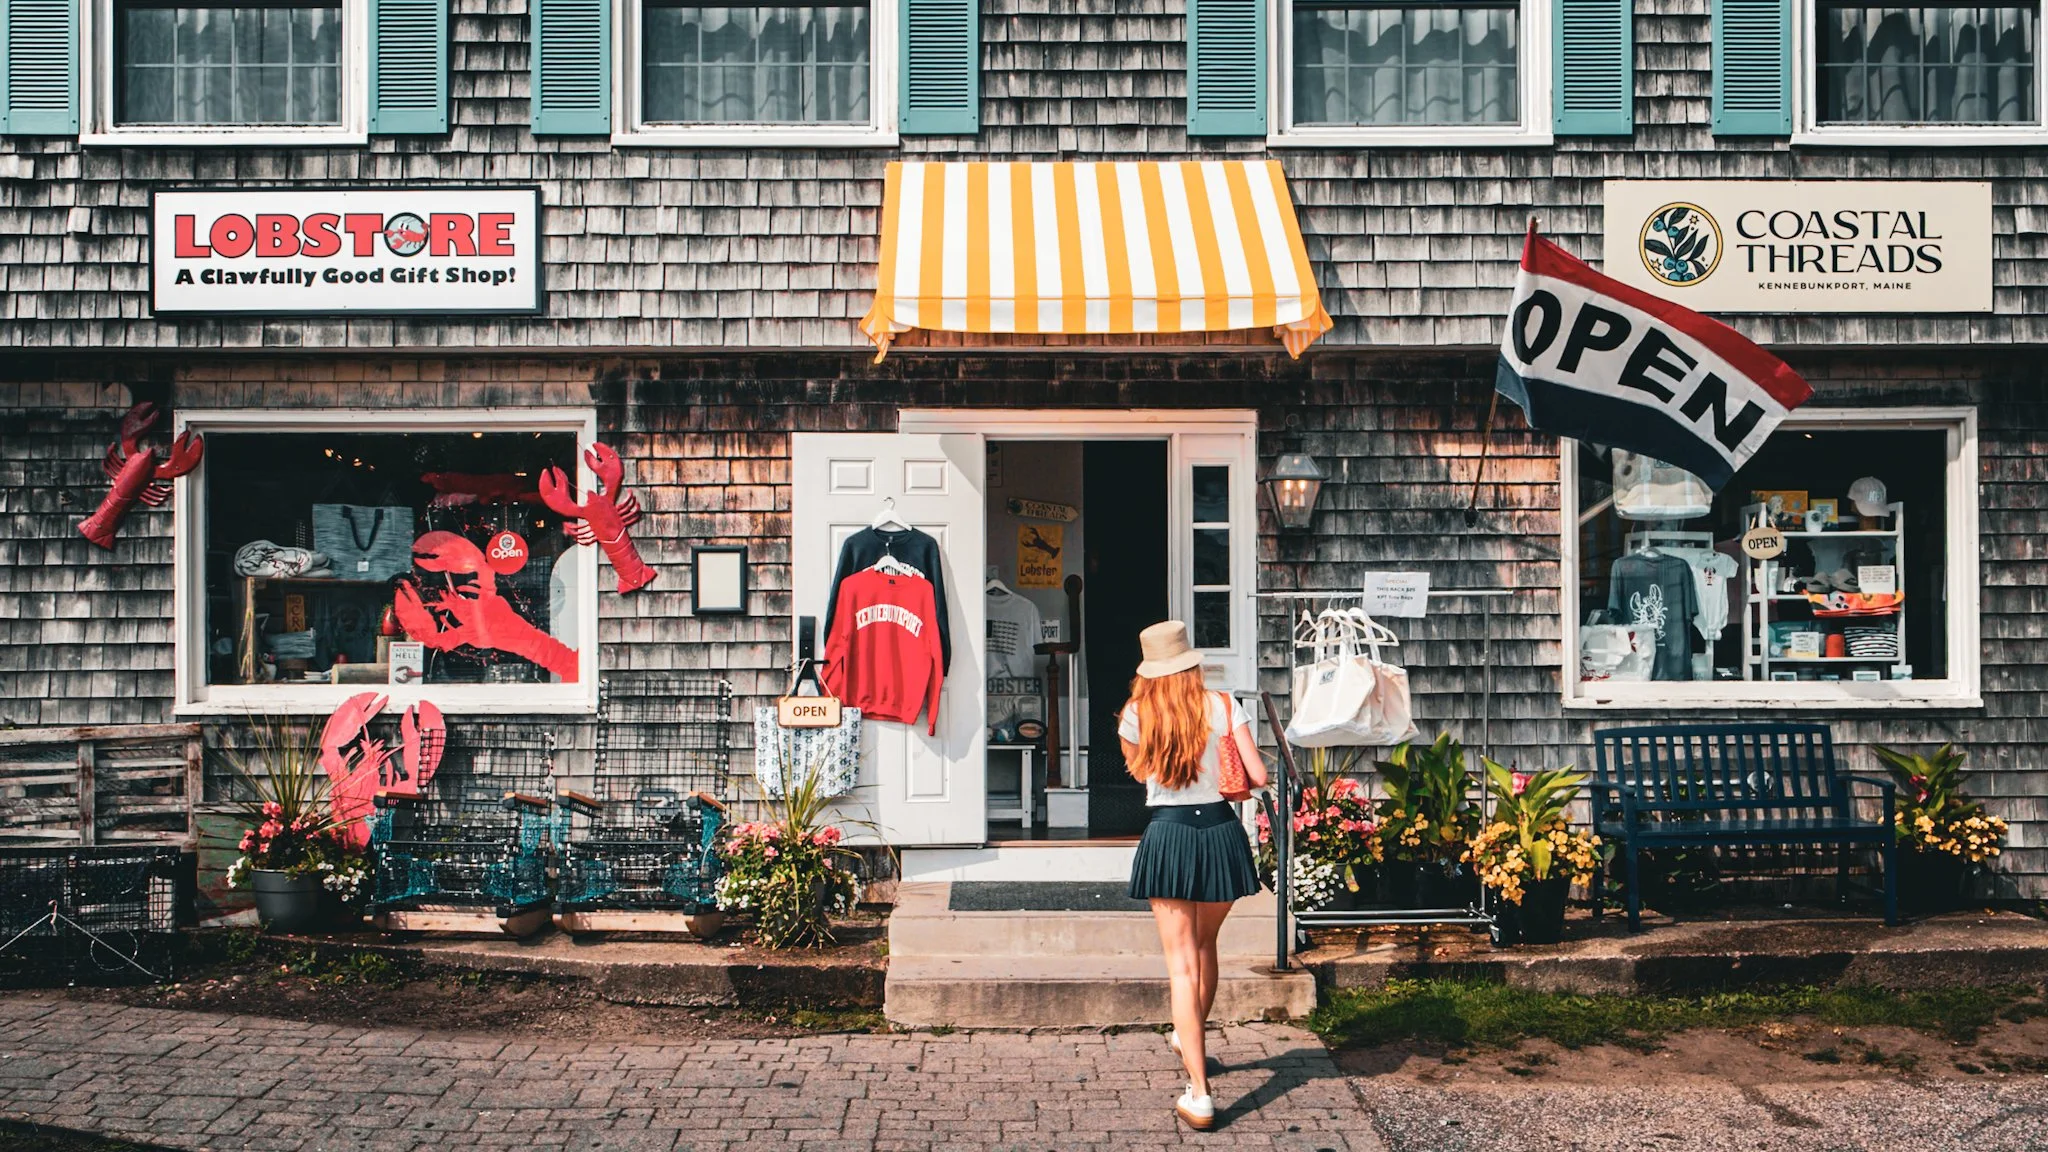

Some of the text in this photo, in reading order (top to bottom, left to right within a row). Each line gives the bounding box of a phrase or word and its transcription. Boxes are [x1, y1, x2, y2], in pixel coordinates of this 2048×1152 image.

[174, 212, 516, 258] LOBSTORE
[1736, 210, 1943, 240] COASTAL
[1736, 244, 1943, 273] THREADS
[175, 267, 516, 287] A Clawfully Good Gift Shop!
[1758, 282, 1912, 290] KENNEBUNKPORT, MAINE
[1512, 289, 1766, 453] OPEN
[1748, 536, 1778, 550] OPEN
[491, 548, 524, 559] Open
[1020, 563, 1057, 576] Lobster
[855, 603, 924, 638] KENNEBUNKPORT
[793, 706, 827, 717] OPEN
